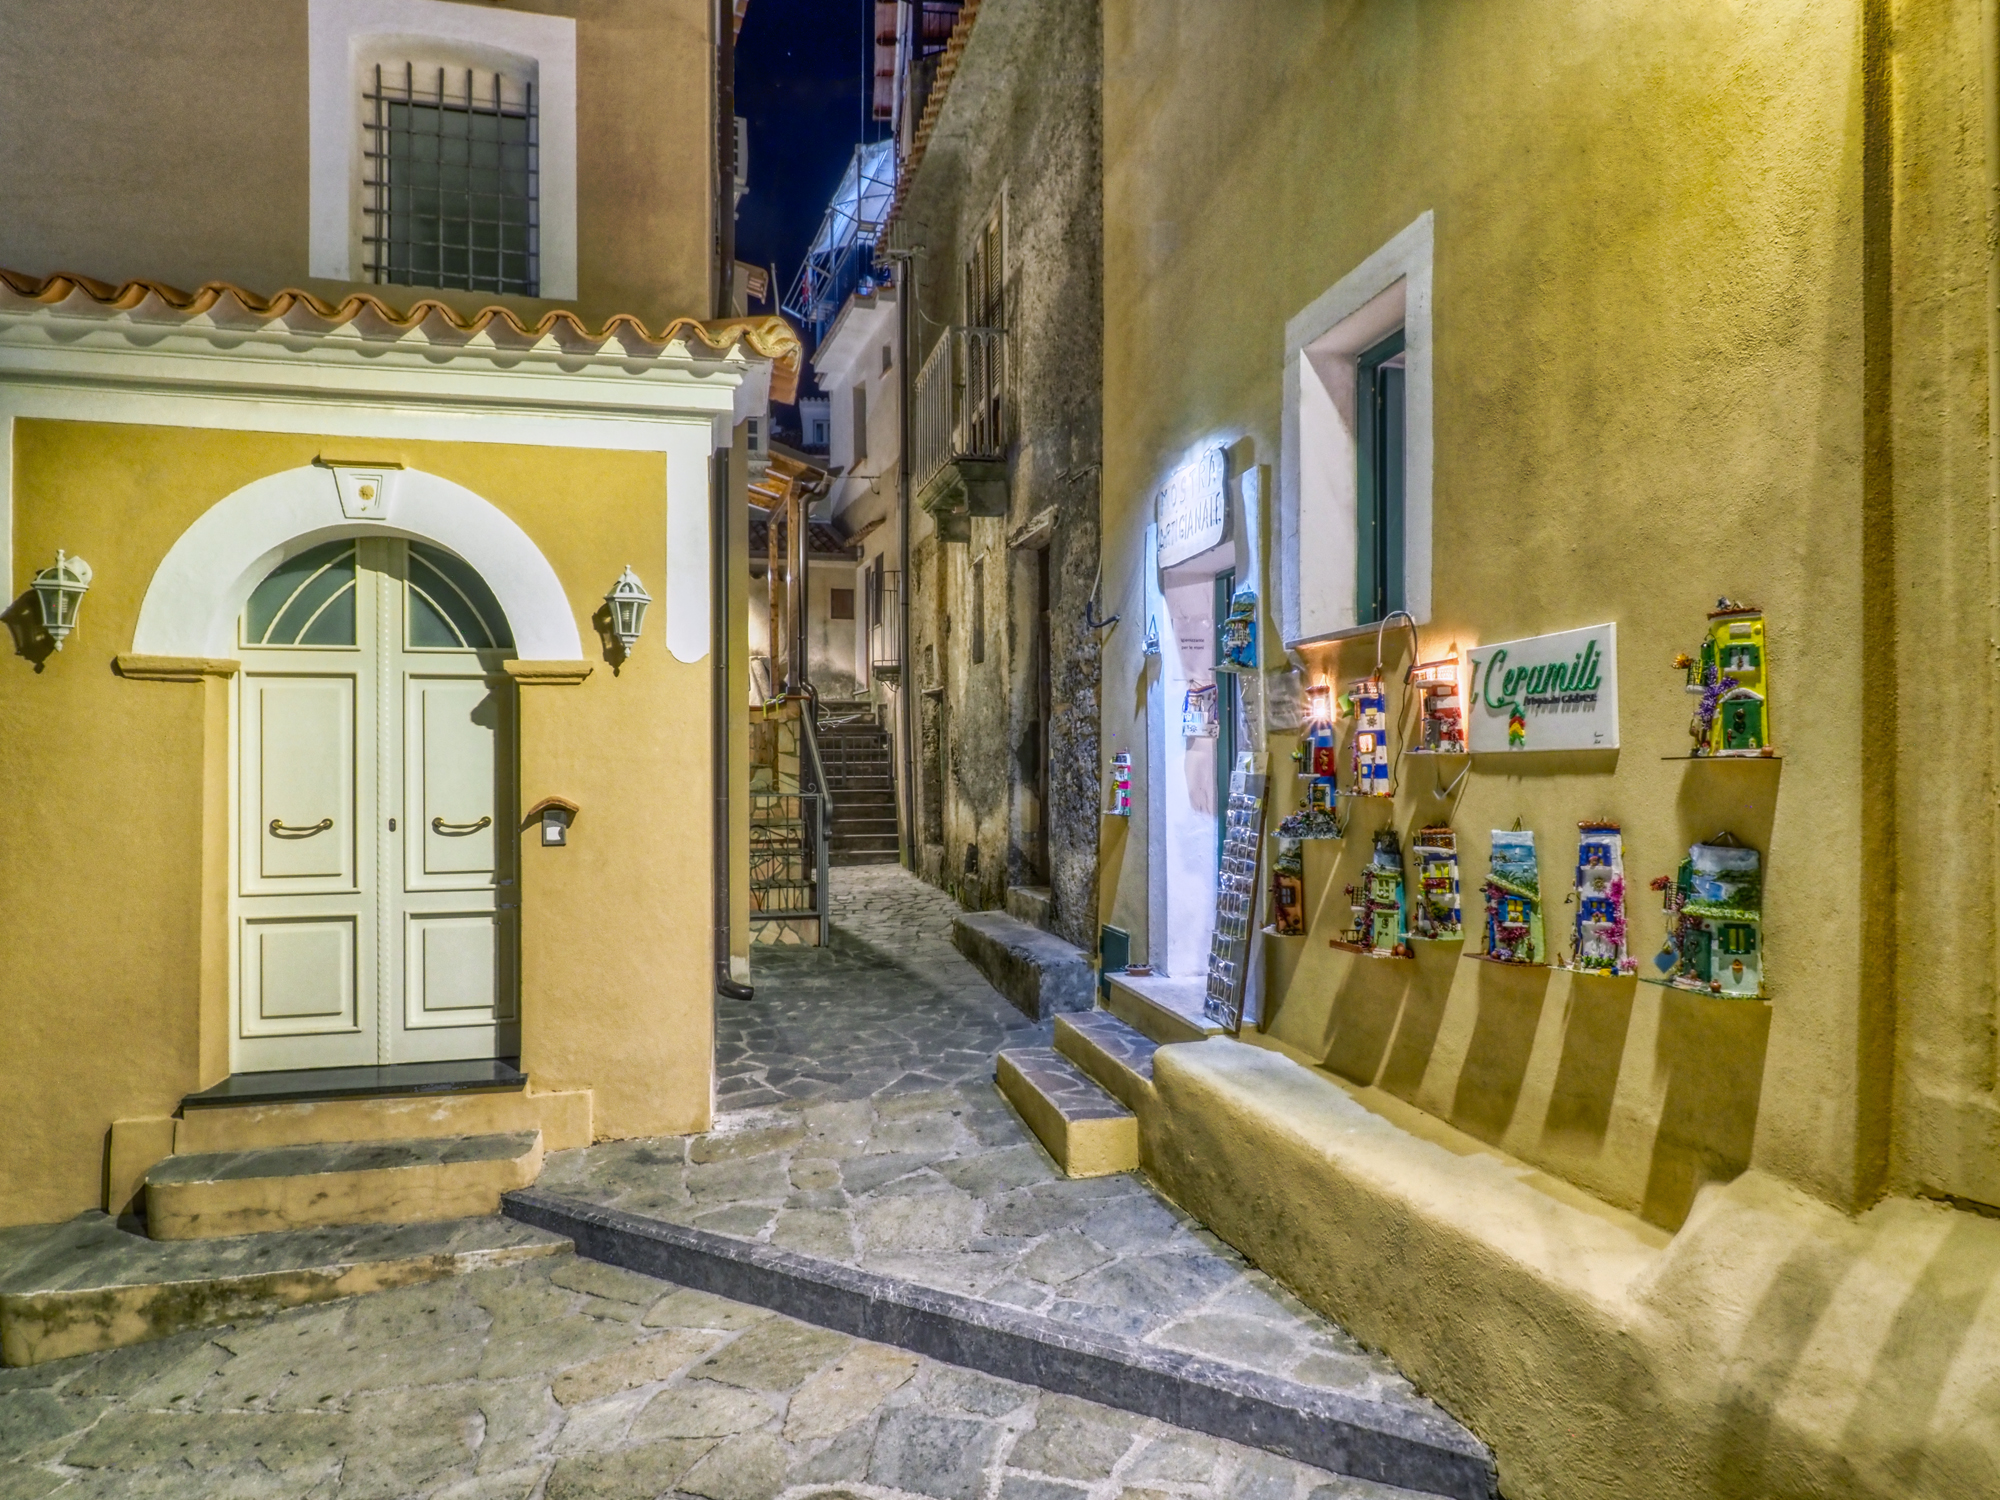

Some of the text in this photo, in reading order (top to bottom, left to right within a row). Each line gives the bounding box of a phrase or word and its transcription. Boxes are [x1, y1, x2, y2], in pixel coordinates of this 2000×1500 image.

[1160, 455, 1217, 516] MOSTRA
[1158, 491, 1222, 553] ARTIGIANALE
[1484, 640, 1602, 709] Ceramili
